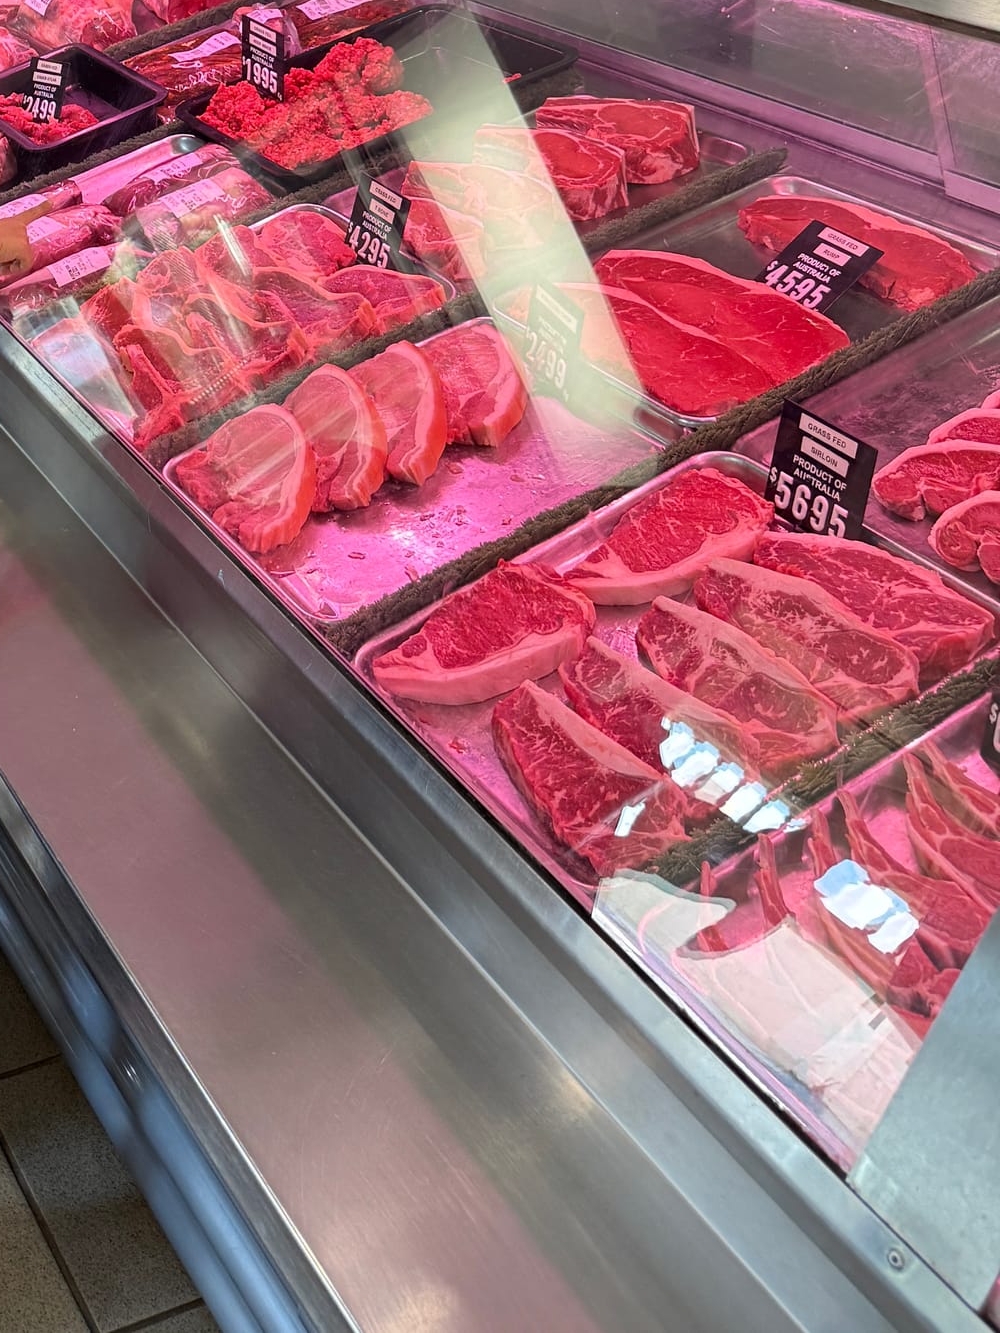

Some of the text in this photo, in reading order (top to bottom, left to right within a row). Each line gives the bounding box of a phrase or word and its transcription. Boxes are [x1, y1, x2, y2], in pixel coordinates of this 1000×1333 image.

[362, 211, 392, 234] PRODUCT OF
[362, 220, 388, 241] AUSTRALIA
[827, 232, 859, 251] GRASS FED
[793, 261, 831, 284] AUSTRALIA
[829, 268, 842, 278] OF
[807, 422, 847, 449] GRASS FED
[810, 446, 839, 467] SIRLOIN
[792, 454, 848, 491] PRODUCT OF
